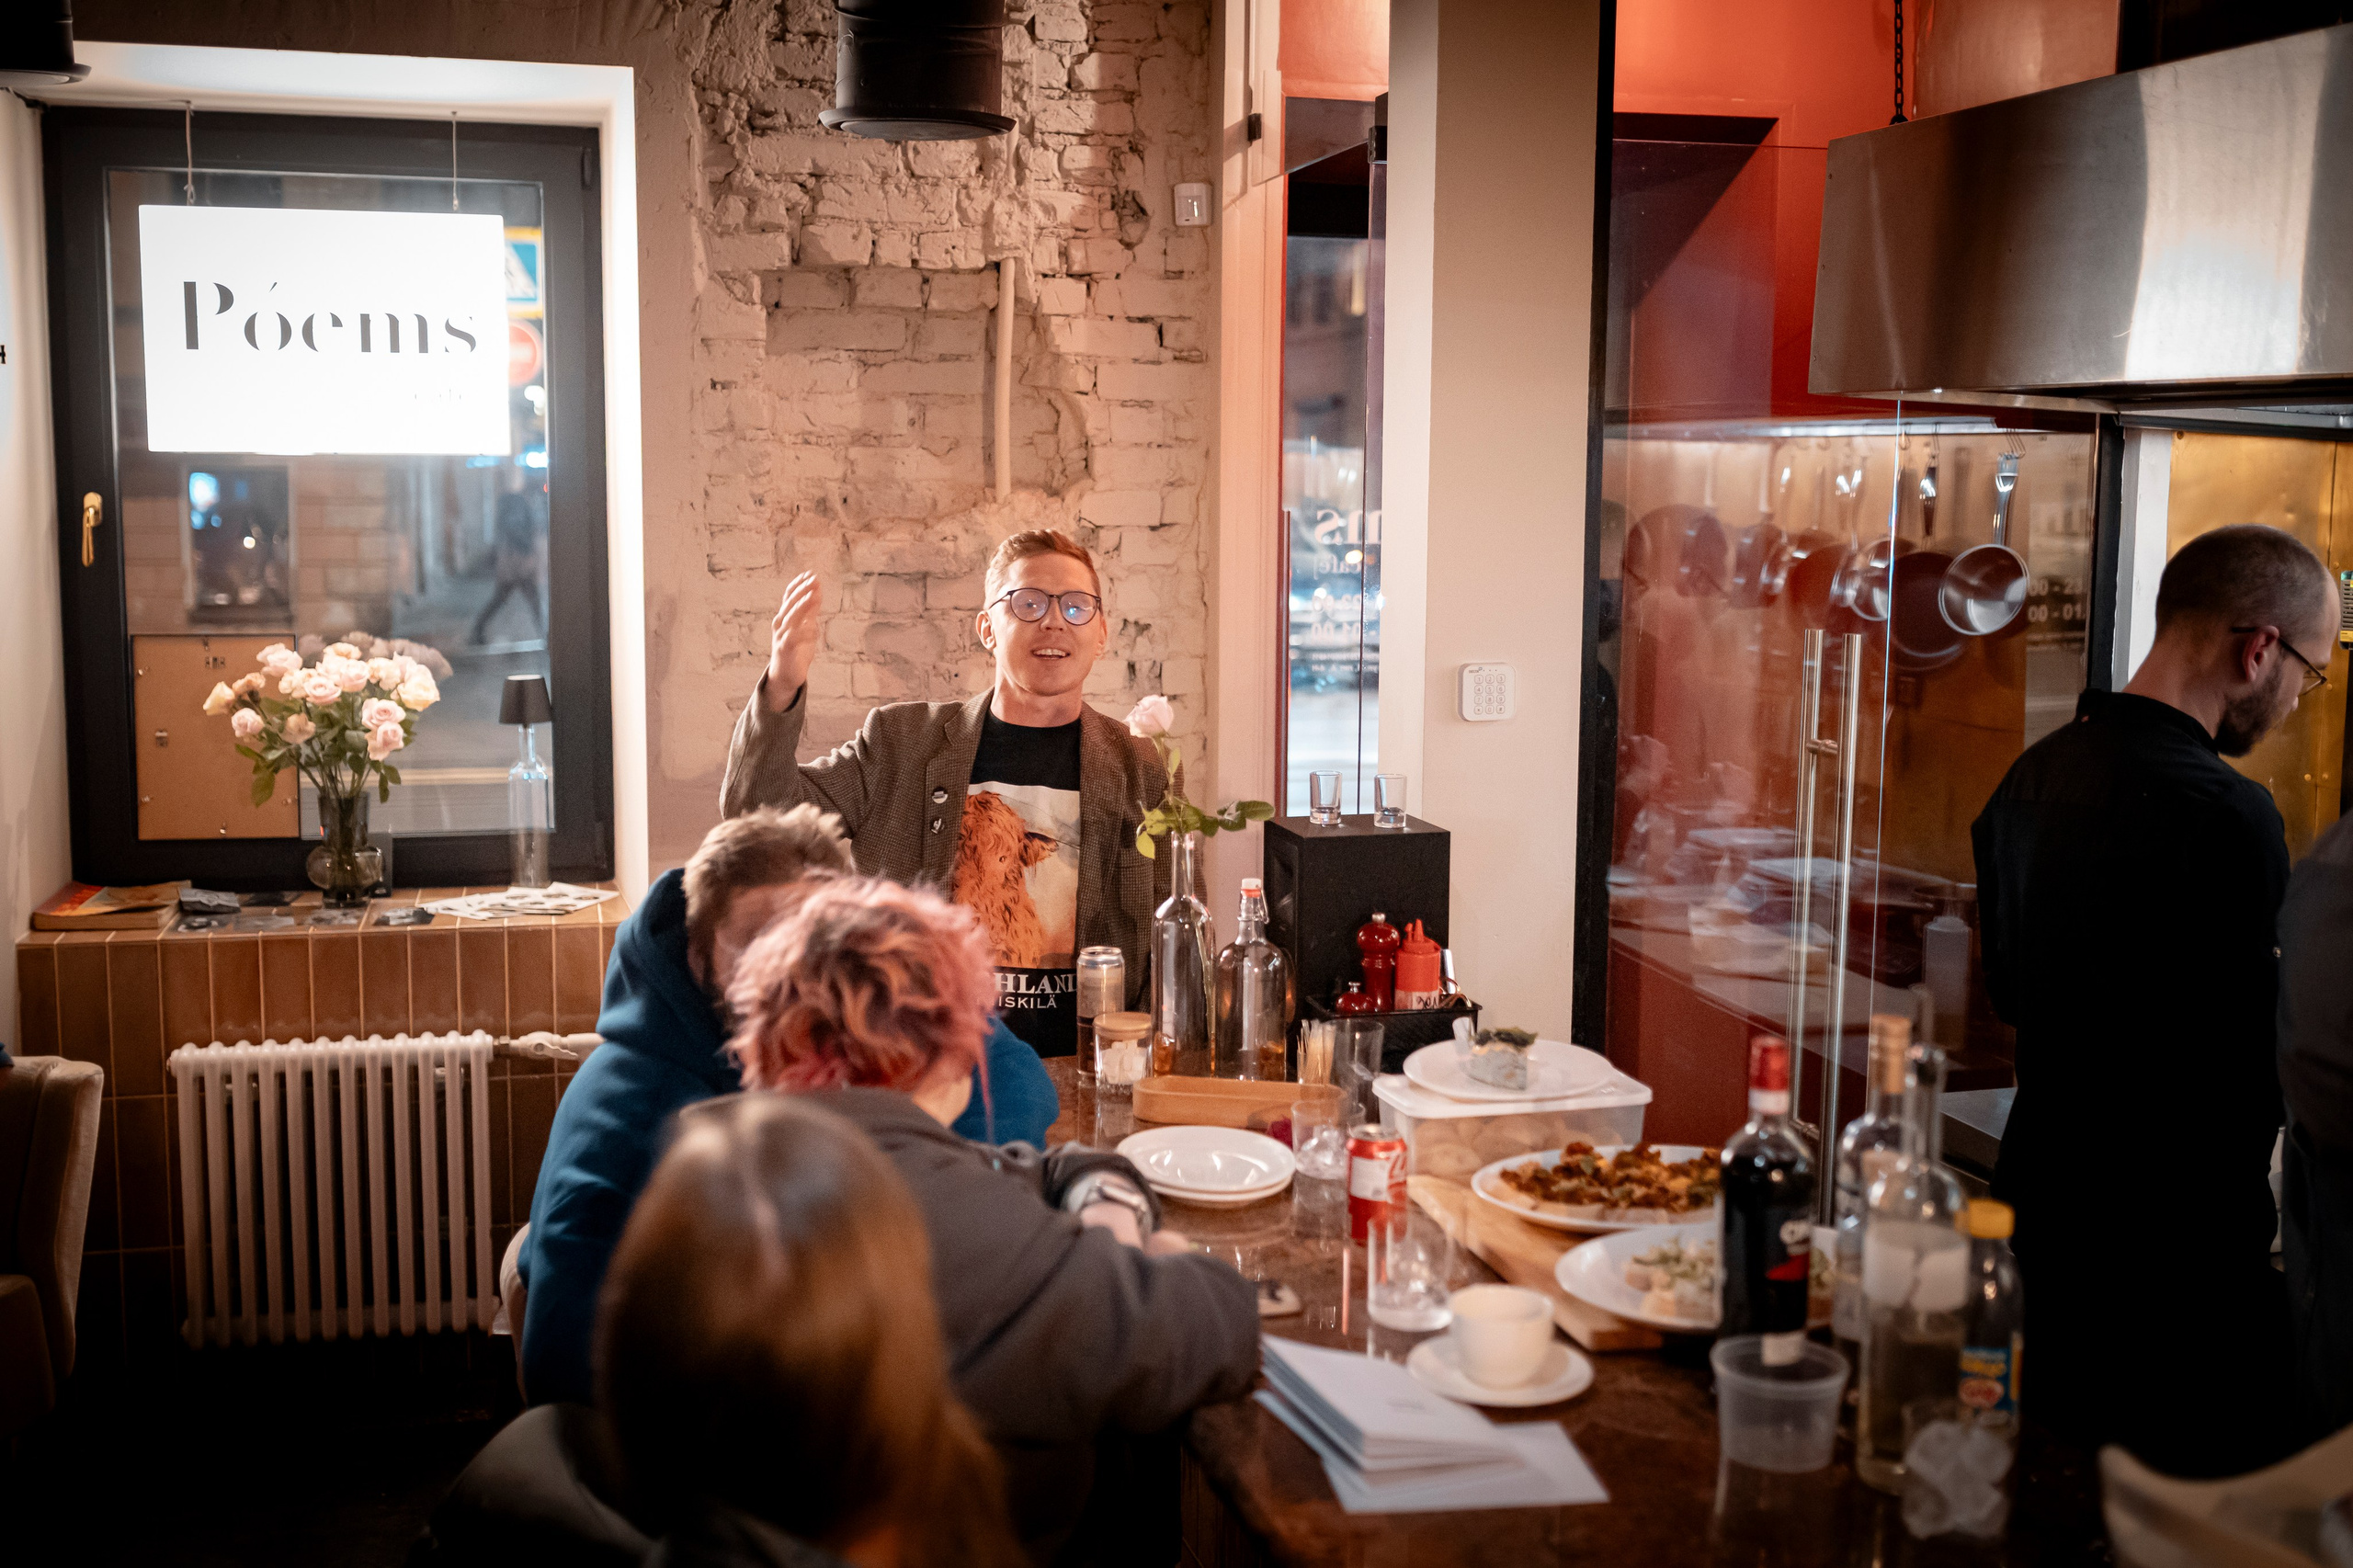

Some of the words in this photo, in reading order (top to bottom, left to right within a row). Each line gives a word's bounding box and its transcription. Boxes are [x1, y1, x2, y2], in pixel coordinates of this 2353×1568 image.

[183, 280, 477, 354] Póems
[994, 972, 1076, 994] HLAN
[998, 994, 1058, 1009] ISKILÄ
